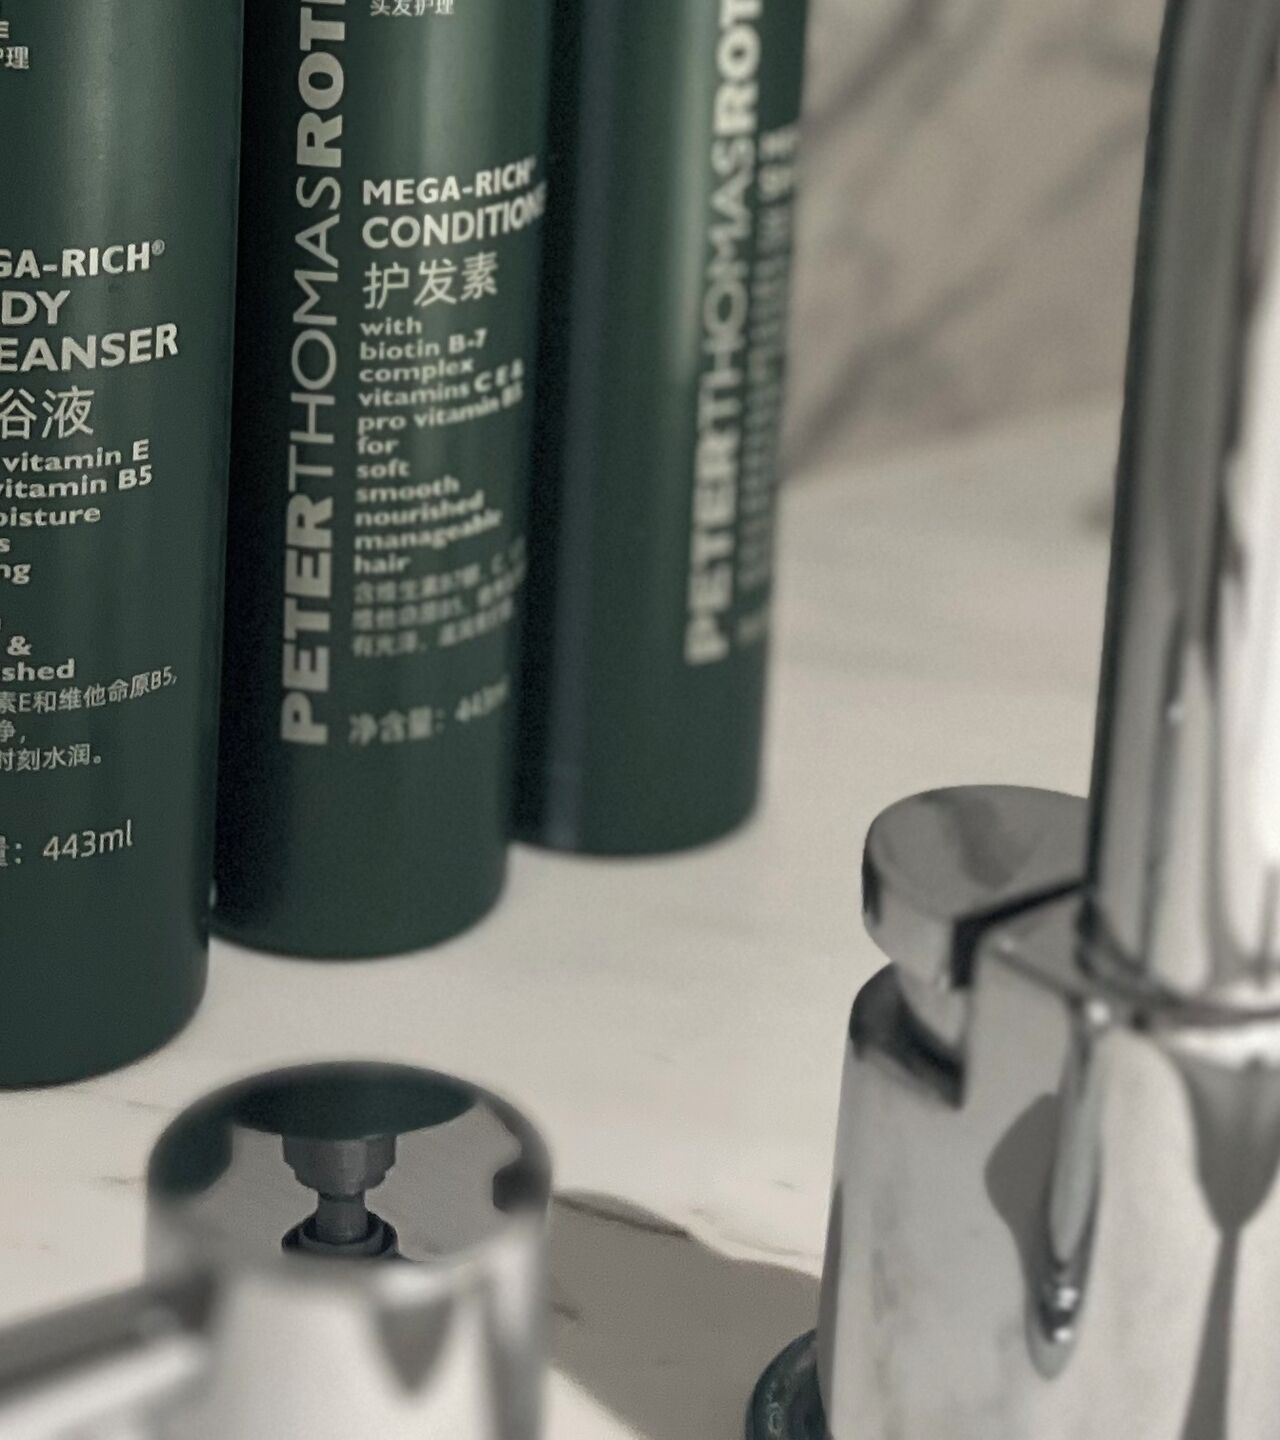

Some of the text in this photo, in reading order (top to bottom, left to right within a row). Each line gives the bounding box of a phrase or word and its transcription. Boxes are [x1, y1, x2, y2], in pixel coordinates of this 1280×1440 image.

[361, 181, 547, 250] CONDITION
[362, 251, 498, 310] 护发素
[360, 317, 423, 336] with
[360, 339, 440, 361] biotin
[360, 359, 473, 385] complex
[358, 382, 470, 407] vitamins
[474, 371, 493, 393] C
[358, 416, 407, 435] pro
[3, 447, 122, 473] vitamin
[133, 439, 150, 462] E
[357, 435, 400, 455] for
[118, 465, 153, 492] B5
[357, 459, 410, 479] soft
[355, 475, 460, 503] smooth
[355, 490, 484, 527] nourished
[354, 553, 410, 574] hair
[6, 635, 32, 658] &
[43, 819, 133, 862] 443ml
